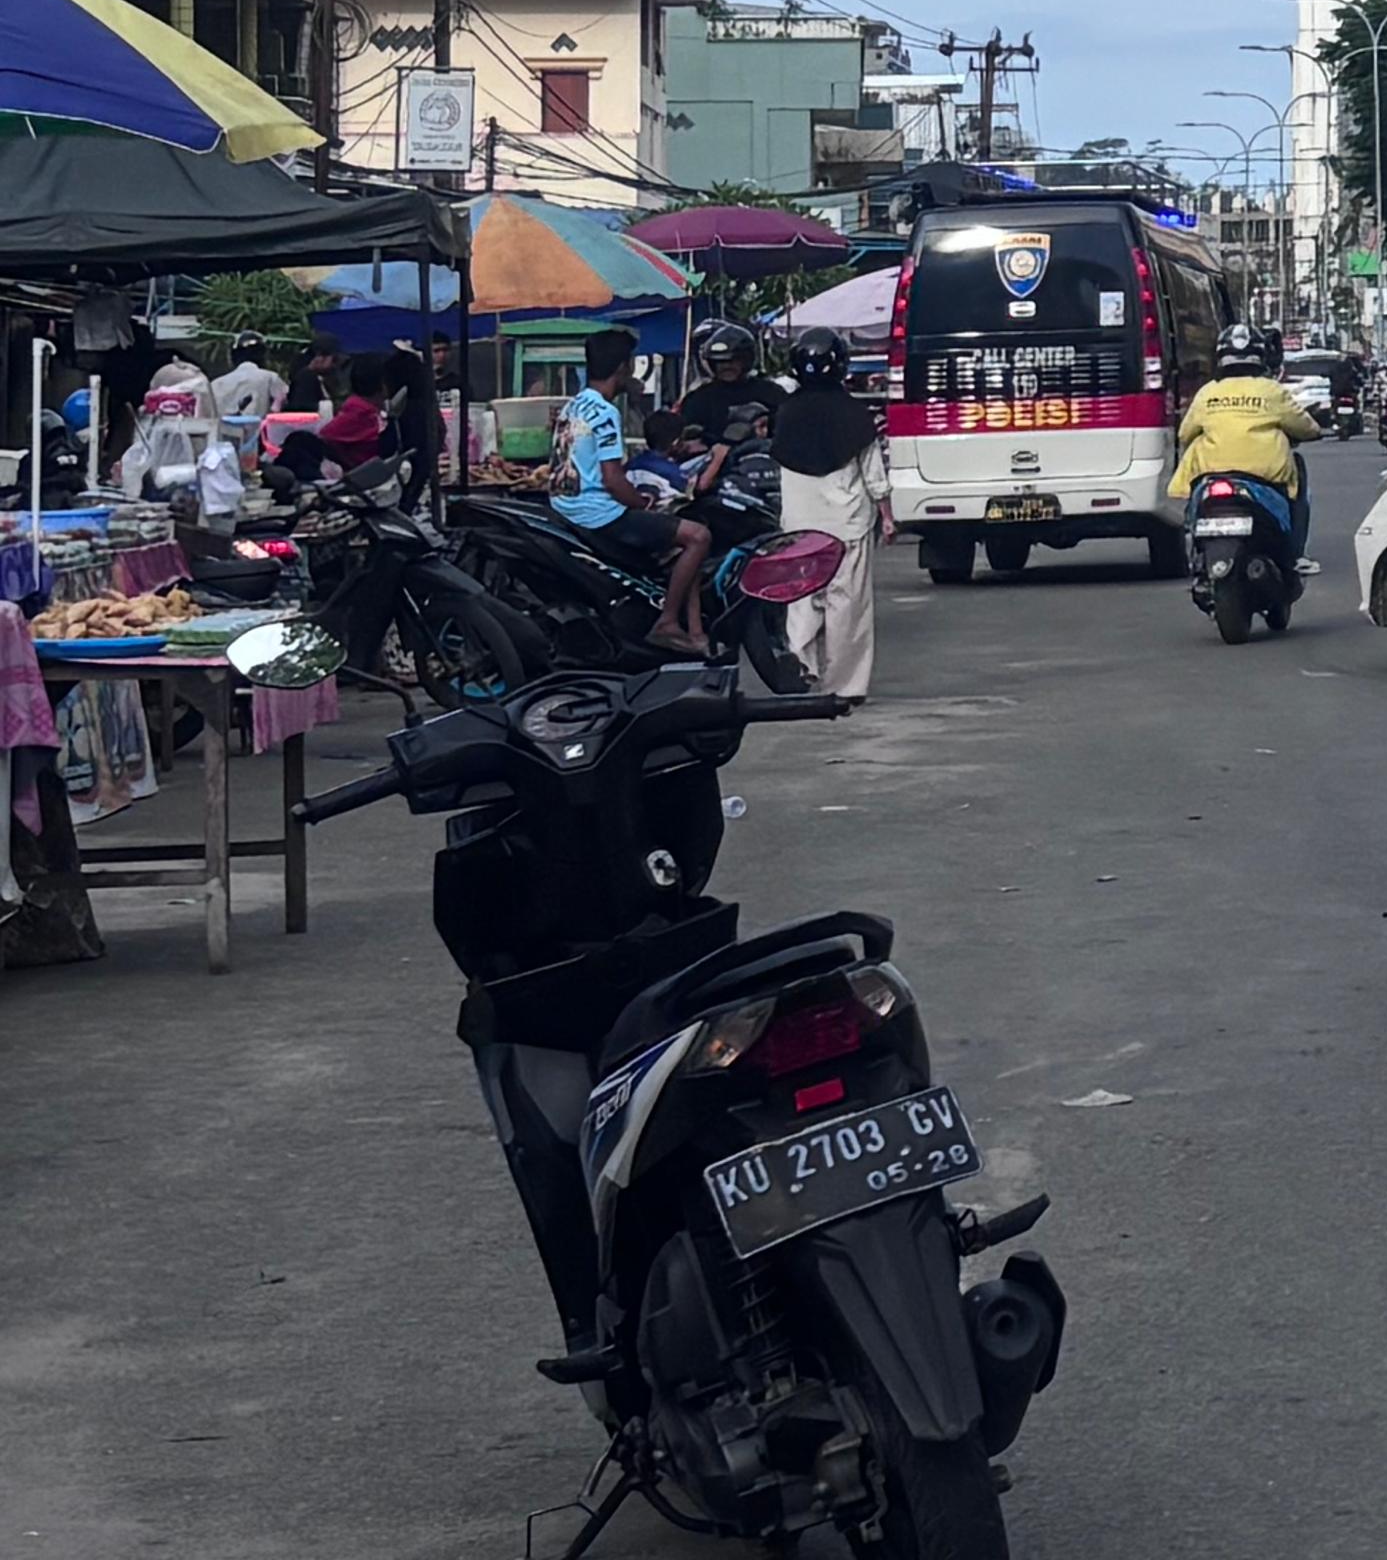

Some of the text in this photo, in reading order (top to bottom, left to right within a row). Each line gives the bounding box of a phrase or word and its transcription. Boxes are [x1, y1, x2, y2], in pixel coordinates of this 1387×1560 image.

[973, 346, 1076, 369] CALL CENTER
[957, 398, 1080, 429] POLISI
[716, 1155, 771, 1208] KU
[787, 1119, 886, 1180] 2703
